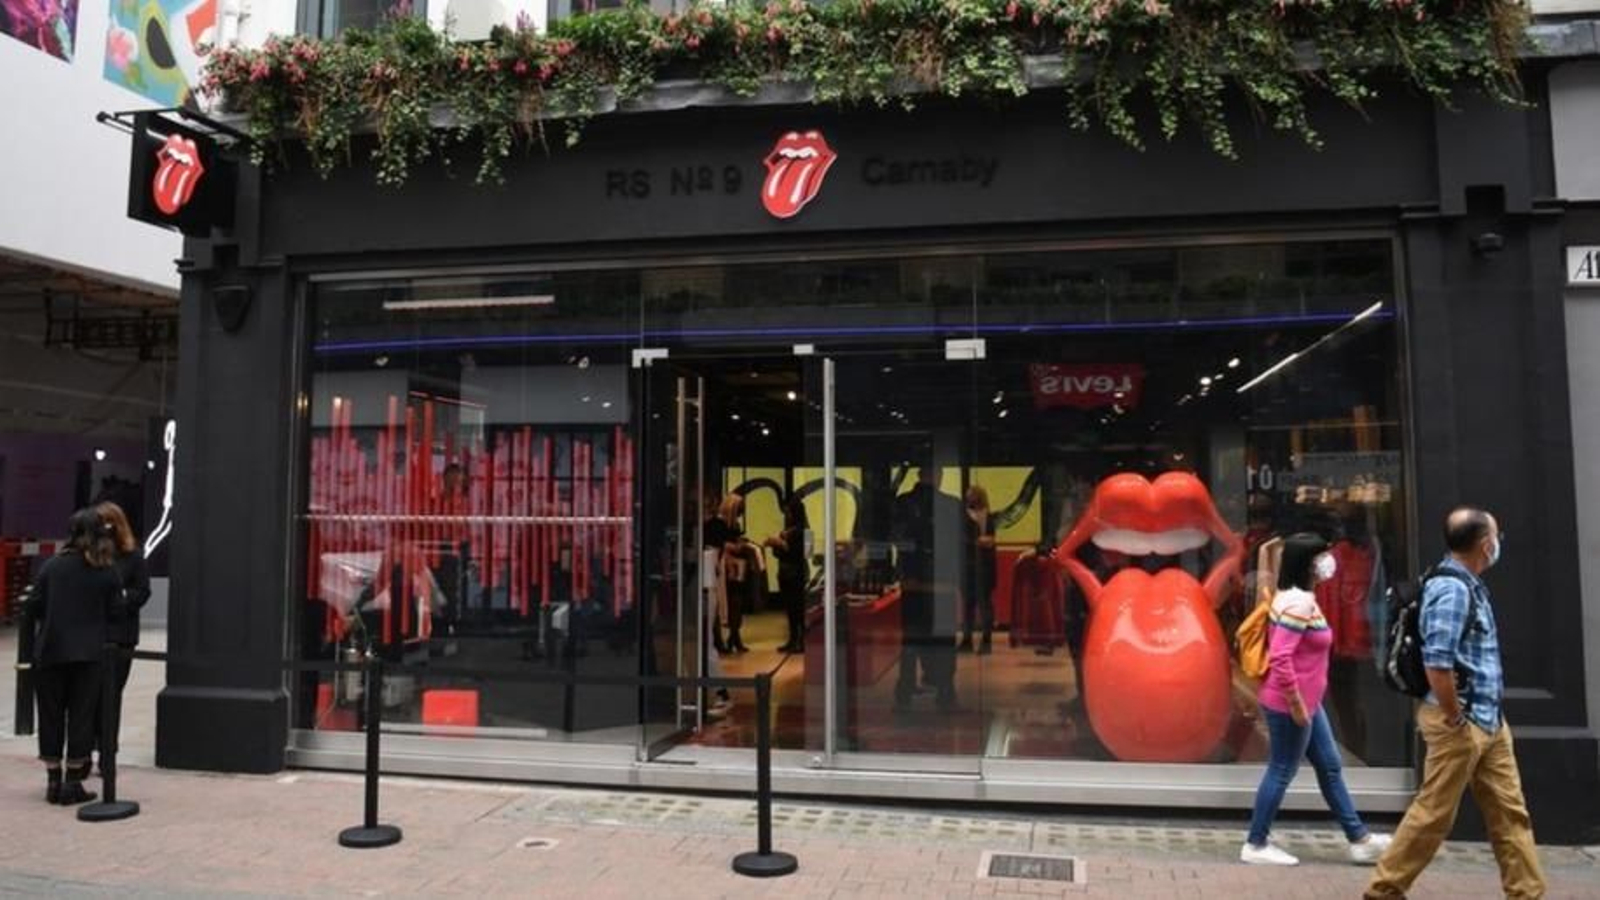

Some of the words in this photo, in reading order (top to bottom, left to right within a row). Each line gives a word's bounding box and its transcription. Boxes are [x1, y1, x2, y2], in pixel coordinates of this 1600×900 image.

[606, 170, 650, 198] RS
[724, 164, 742, 195] 9
[862, 153, 999, 187] Carnaby
